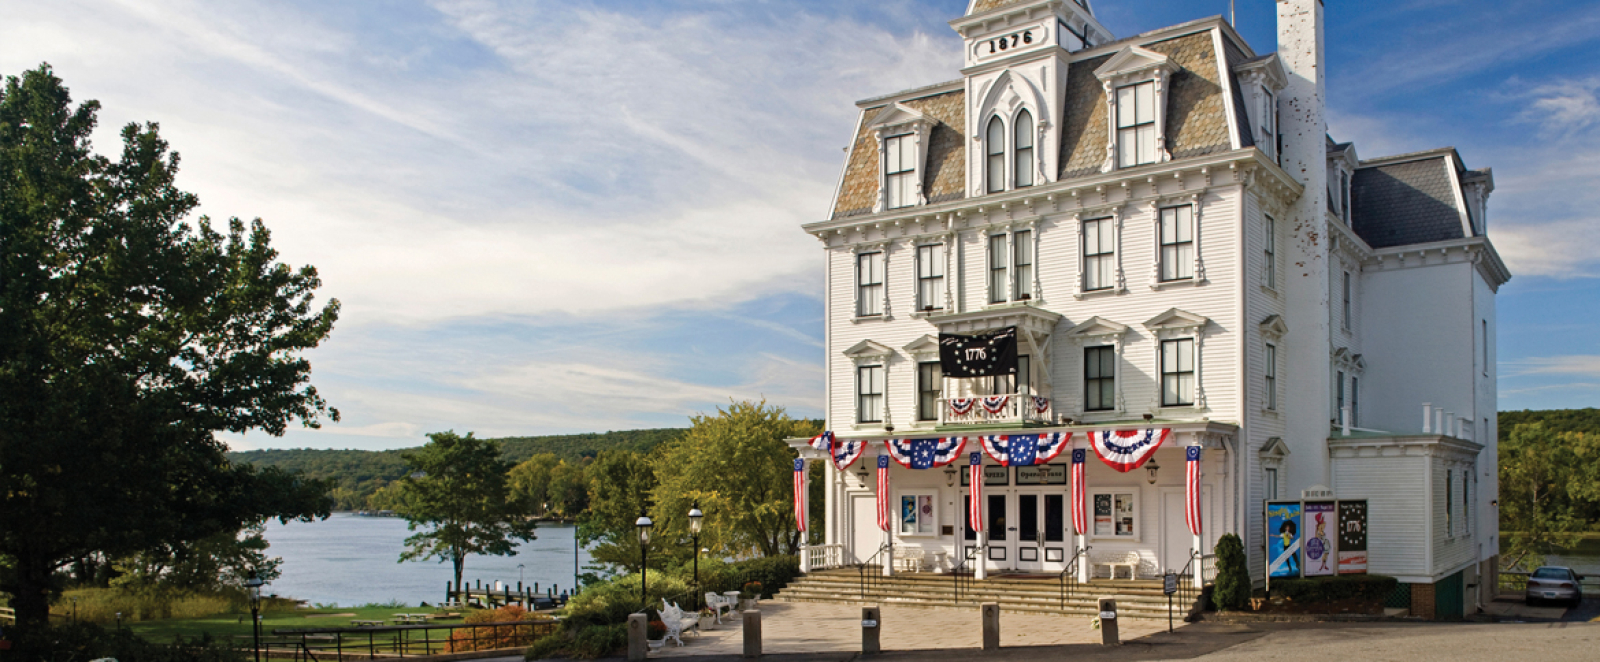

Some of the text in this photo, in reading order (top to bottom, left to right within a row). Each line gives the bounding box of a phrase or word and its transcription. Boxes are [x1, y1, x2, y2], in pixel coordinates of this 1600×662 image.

[989, 30, 1033, 53] 1876
[965, 347, 987, 361] 1776
[1020, 471, 1040, 480] Opera
[1346, 520, 1361, 533] 1776
